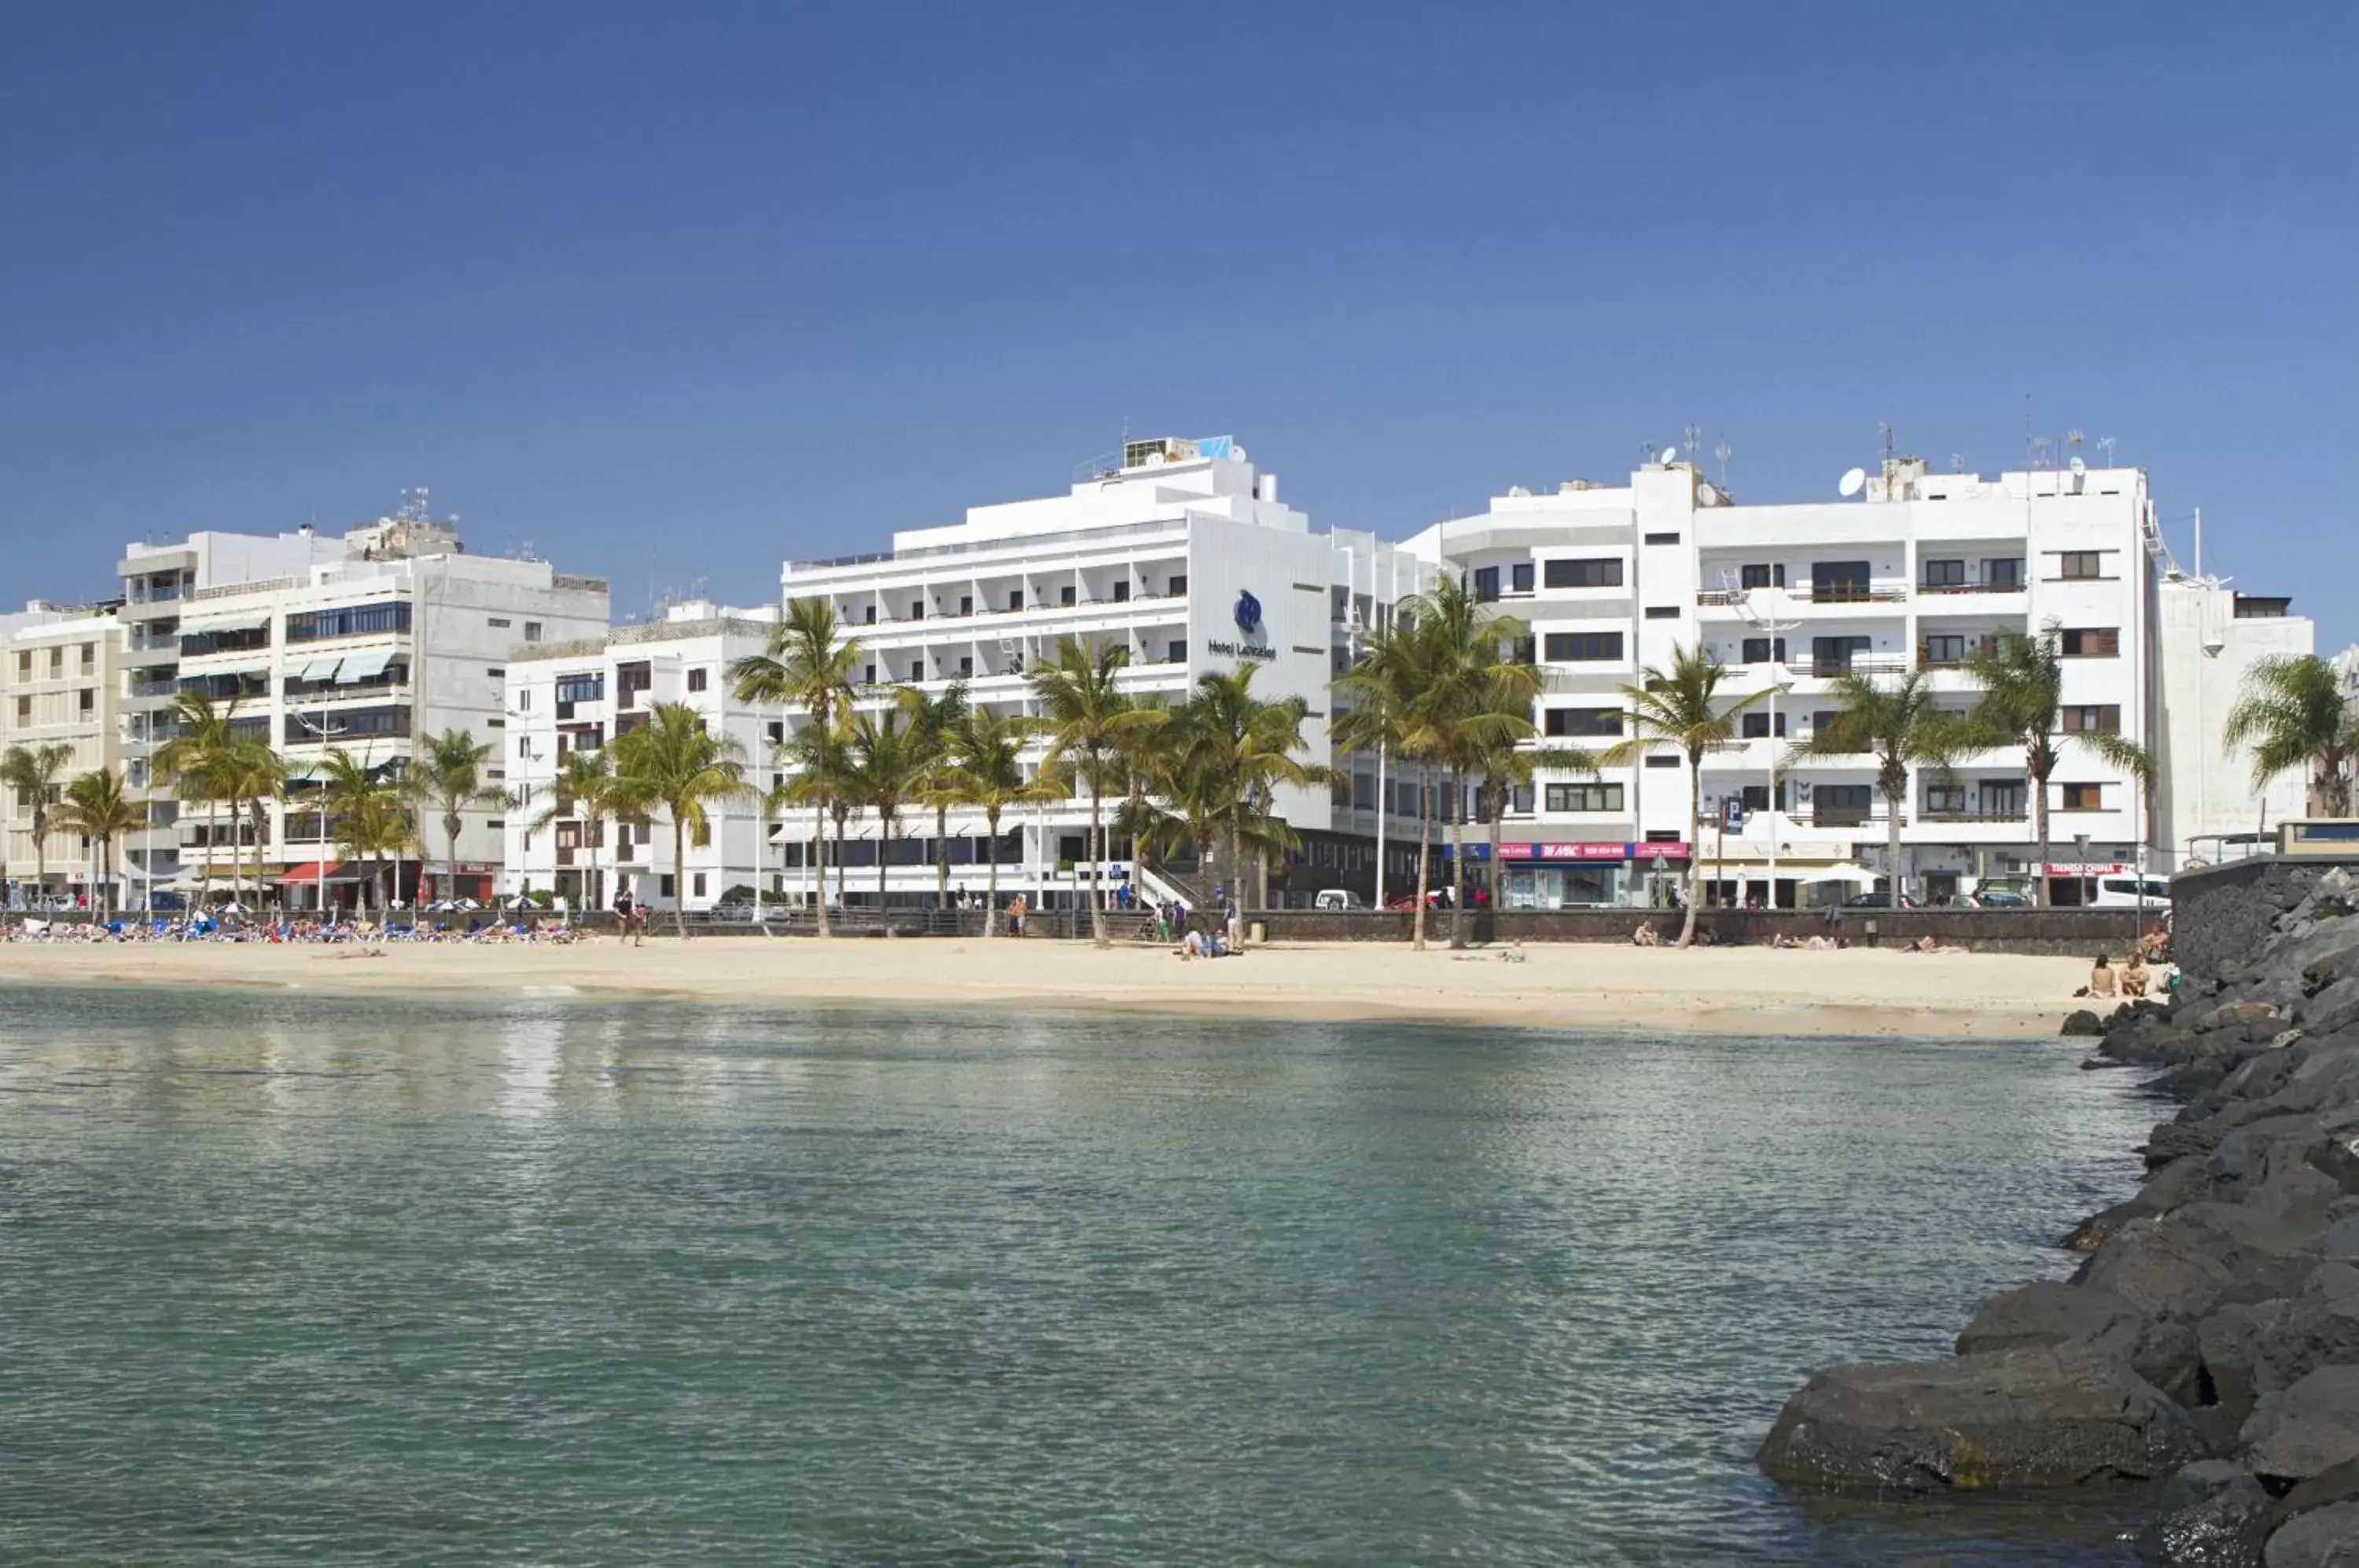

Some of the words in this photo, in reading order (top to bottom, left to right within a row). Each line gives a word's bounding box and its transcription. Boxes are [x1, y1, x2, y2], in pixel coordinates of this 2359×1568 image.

[1208, 639, 1235, 656] Hotel
[1730, 801, 1739, 819] P
[2052, 863, 2083, 872] TIENDA
[2085, 863, 2114, 872] CHINA
